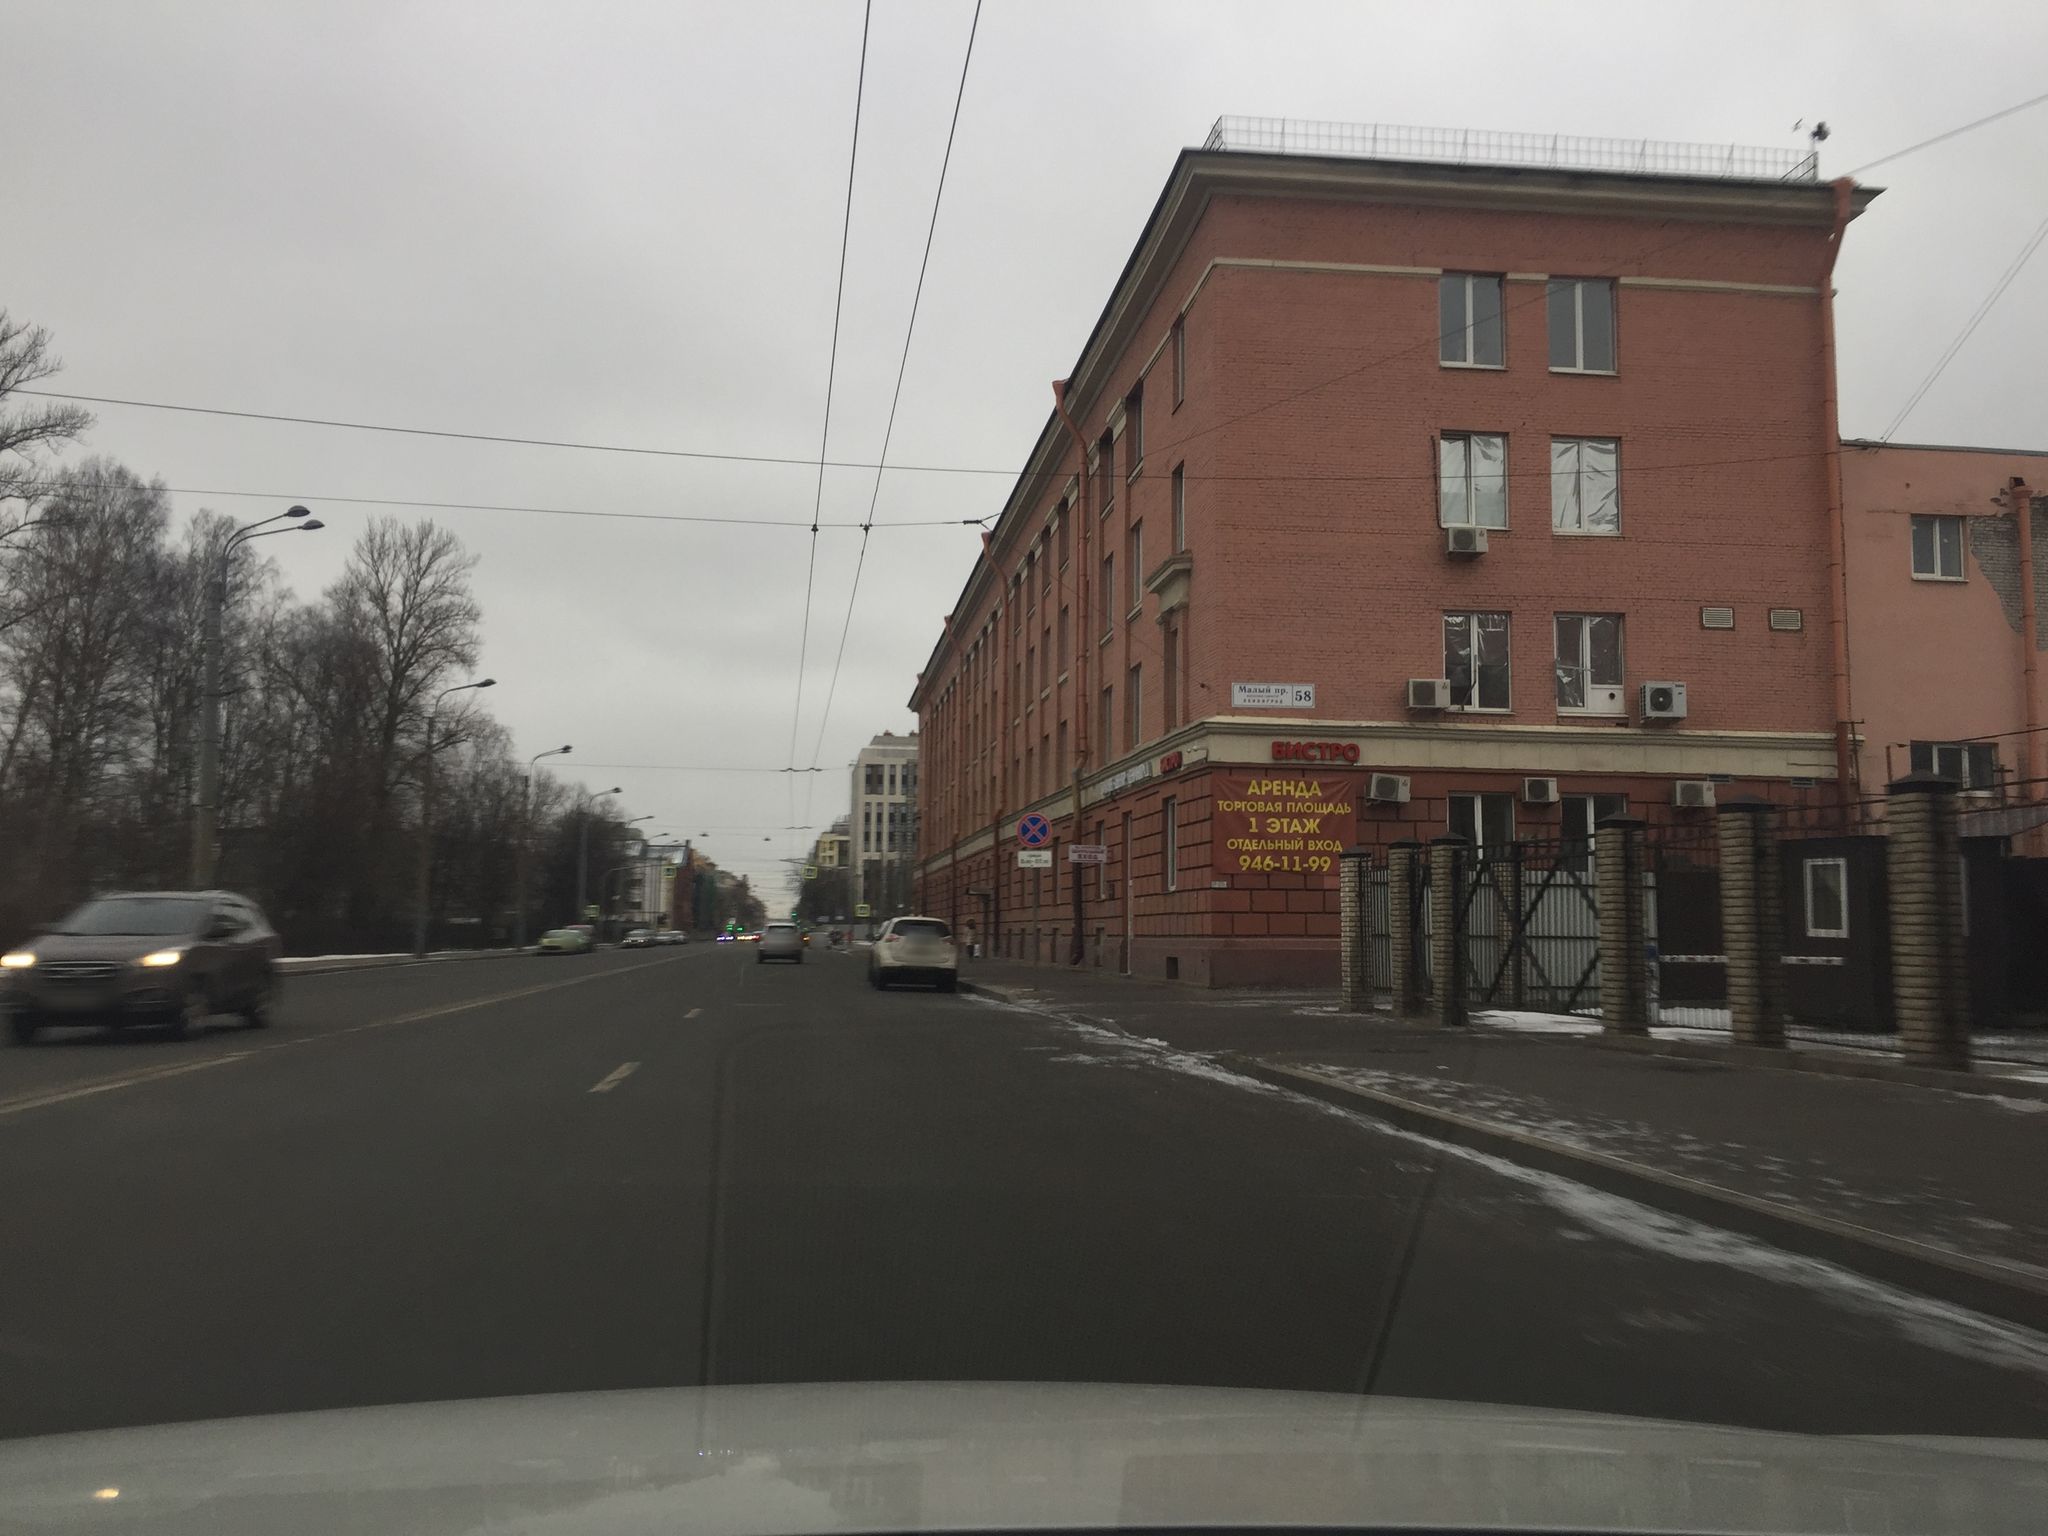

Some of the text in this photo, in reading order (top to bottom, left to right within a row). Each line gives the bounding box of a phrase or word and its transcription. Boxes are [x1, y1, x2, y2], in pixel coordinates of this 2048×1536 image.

[1238, 685, 1289, 695] Малый пр.
[1295, 690, 1312, 702] 58
[1271, 741, 1361, 763] БИСТРО
[1247, 780, 1322, 799] АРЕНДА
[1217, 800, 1352, 814] ТОРГОВАЯ ПЛОЩАДЬ
[1248, 817, 1320, 834] 1 ЭТАЖ
[1227, 837, 1343, 853] ОТДЕЛЬНЫЙ ВХОД
[1239, 856, 1332, 872] 946-11-99
